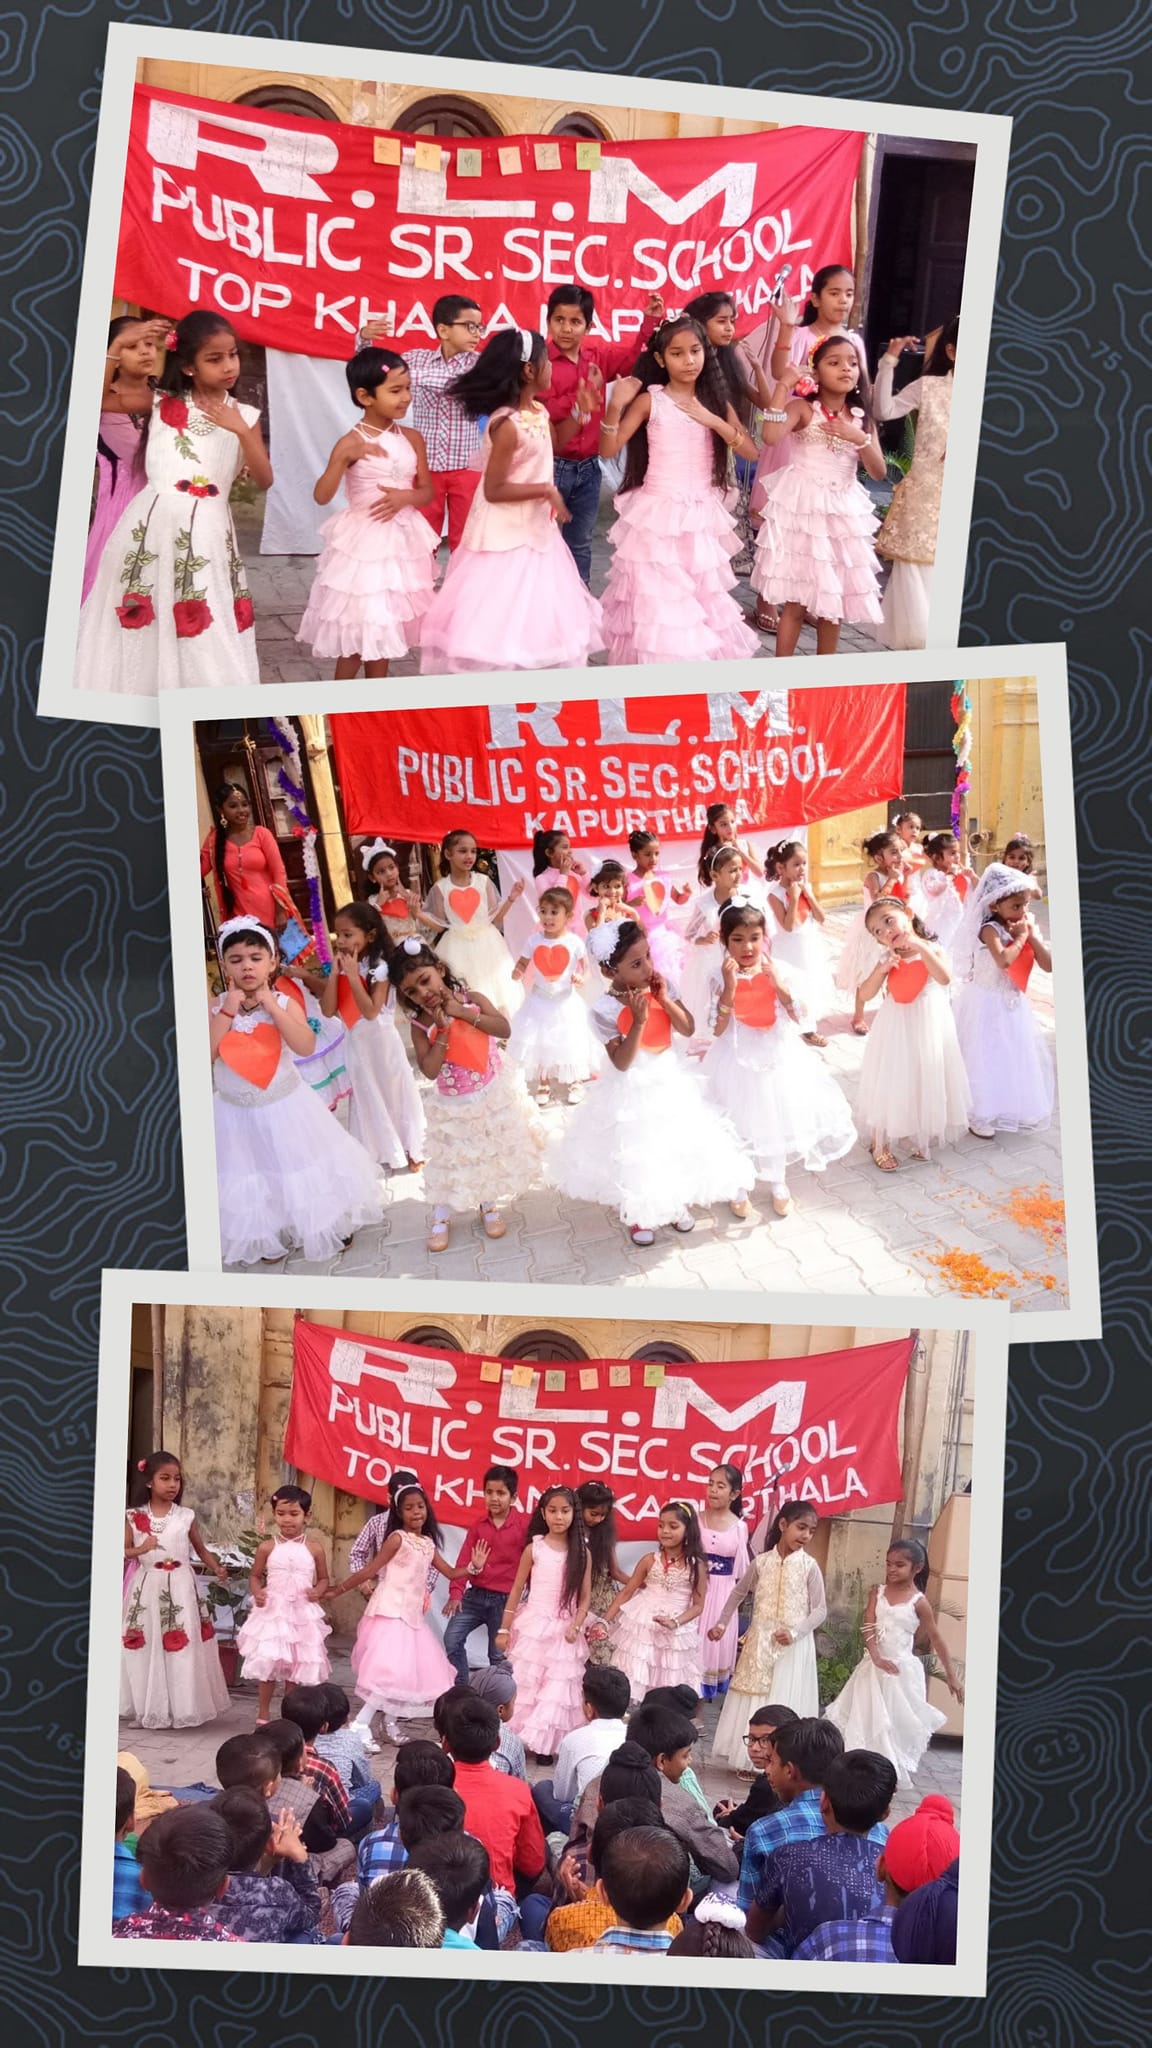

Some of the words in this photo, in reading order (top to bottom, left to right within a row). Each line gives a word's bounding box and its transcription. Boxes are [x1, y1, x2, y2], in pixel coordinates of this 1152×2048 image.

[151, 165, 361, 271] PUBLIC
[177, 256, 292, 318] TOP
[397, 745, 525, 806] PUBLIC
[523, 797, 757, 841] KAPURTHAA
[48, 1421, 91, 1451] 151
[327, 1382, 471, 1460] PUBLIC
[1033, 1732, 1081, 1765] 213
